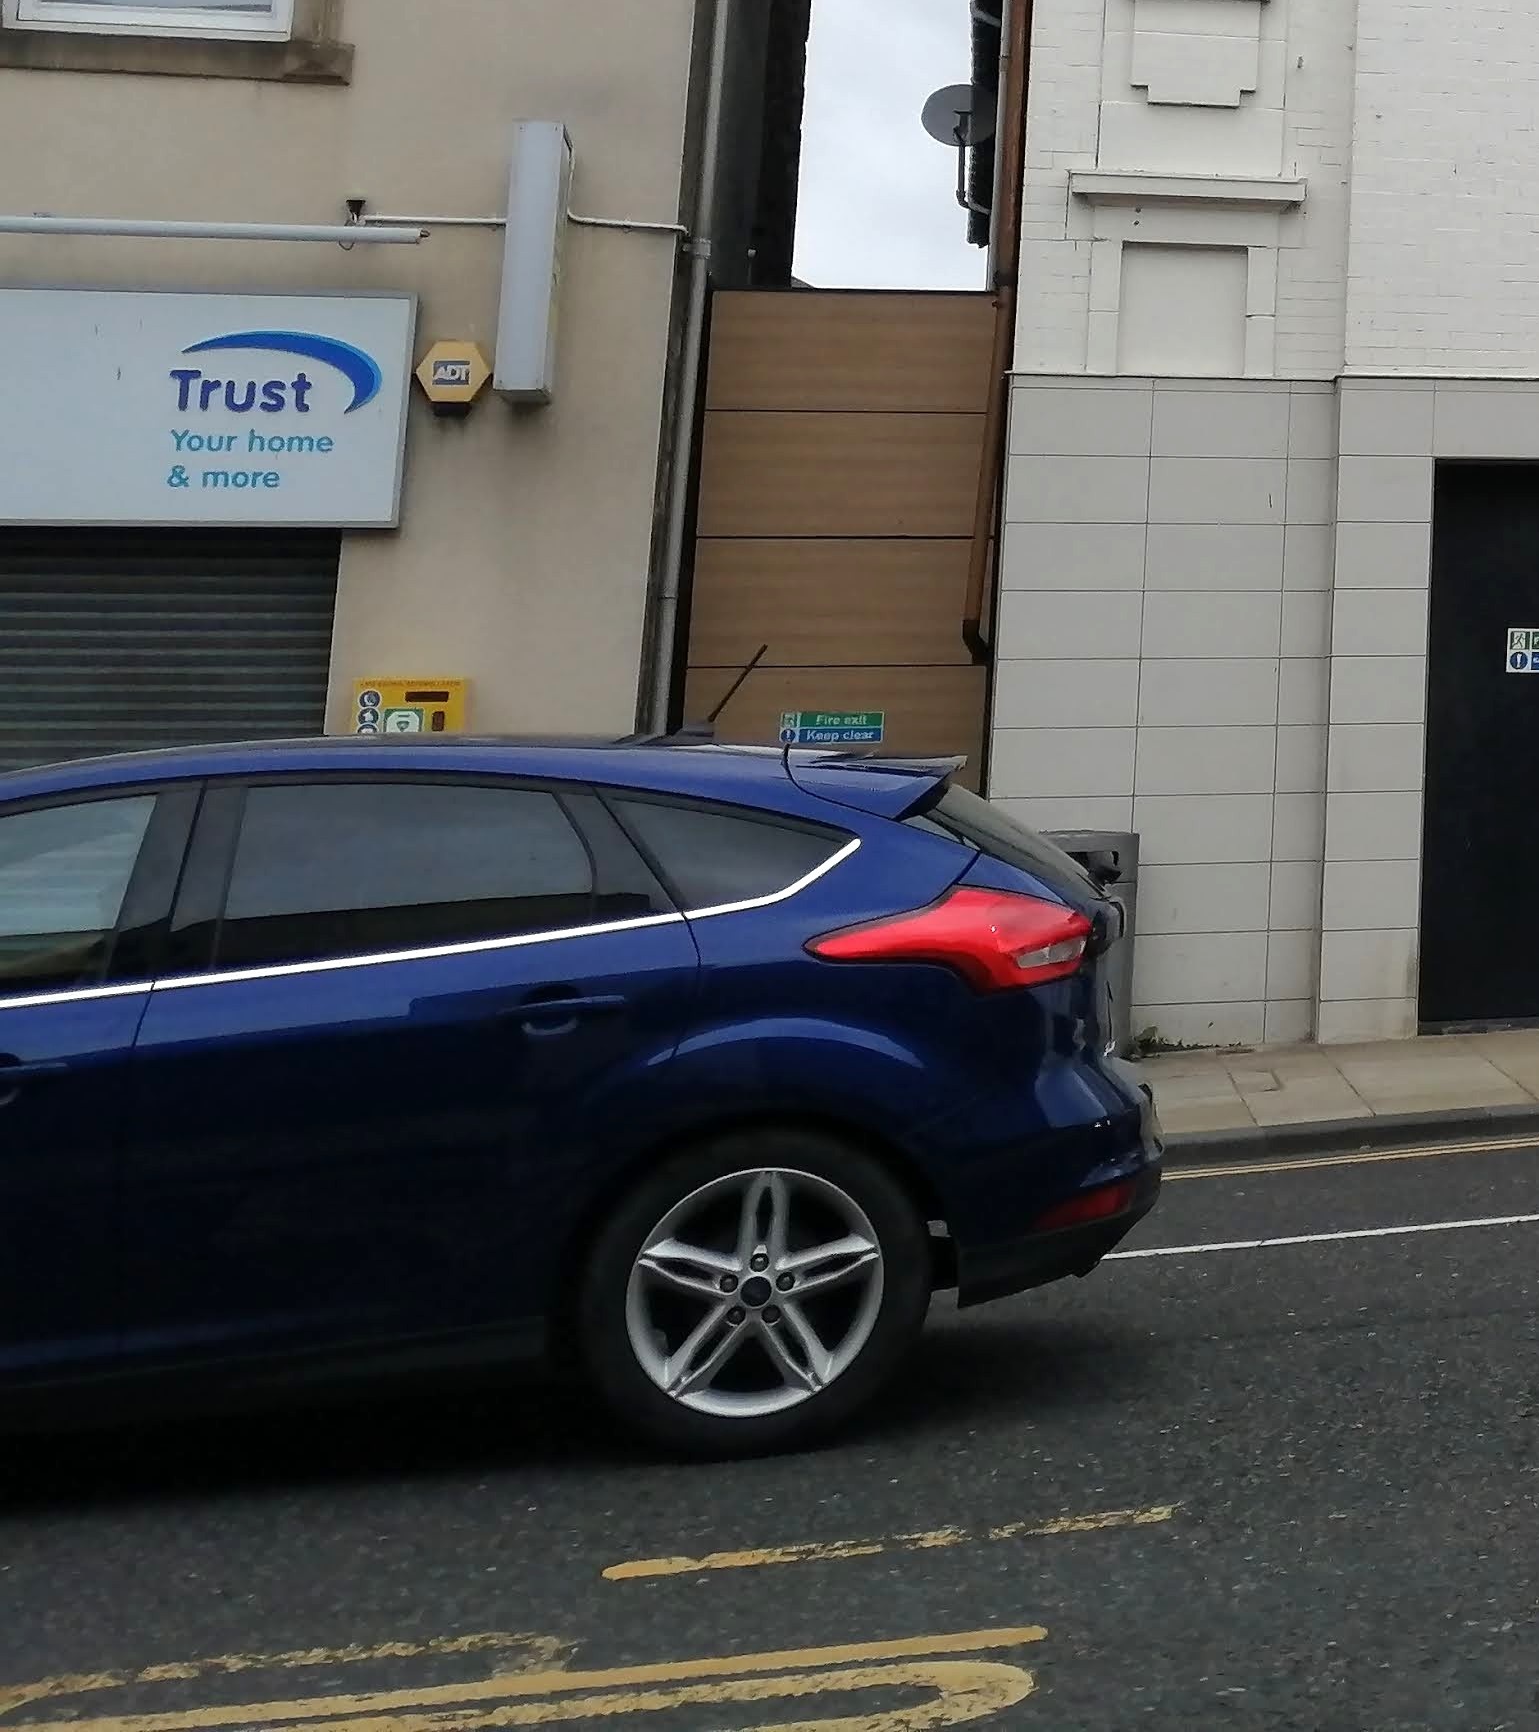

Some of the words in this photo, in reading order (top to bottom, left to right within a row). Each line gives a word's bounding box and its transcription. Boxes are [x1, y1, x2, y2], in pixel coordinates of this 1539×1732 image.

[432, 364, 471, 381] ADT
[169, 369, 313, 413] Trust
[170, 428, 238, 452] Your
[247, 428, 334, 453] home
[166, 464, 190, 488] &
[202, 470, 281, 488] more
[816, 714, 841, 726] Fire
[844, 714, 867, 726] exit
[806, 729, 840, 741] Keep
[843, 730, 875, 740] clear
